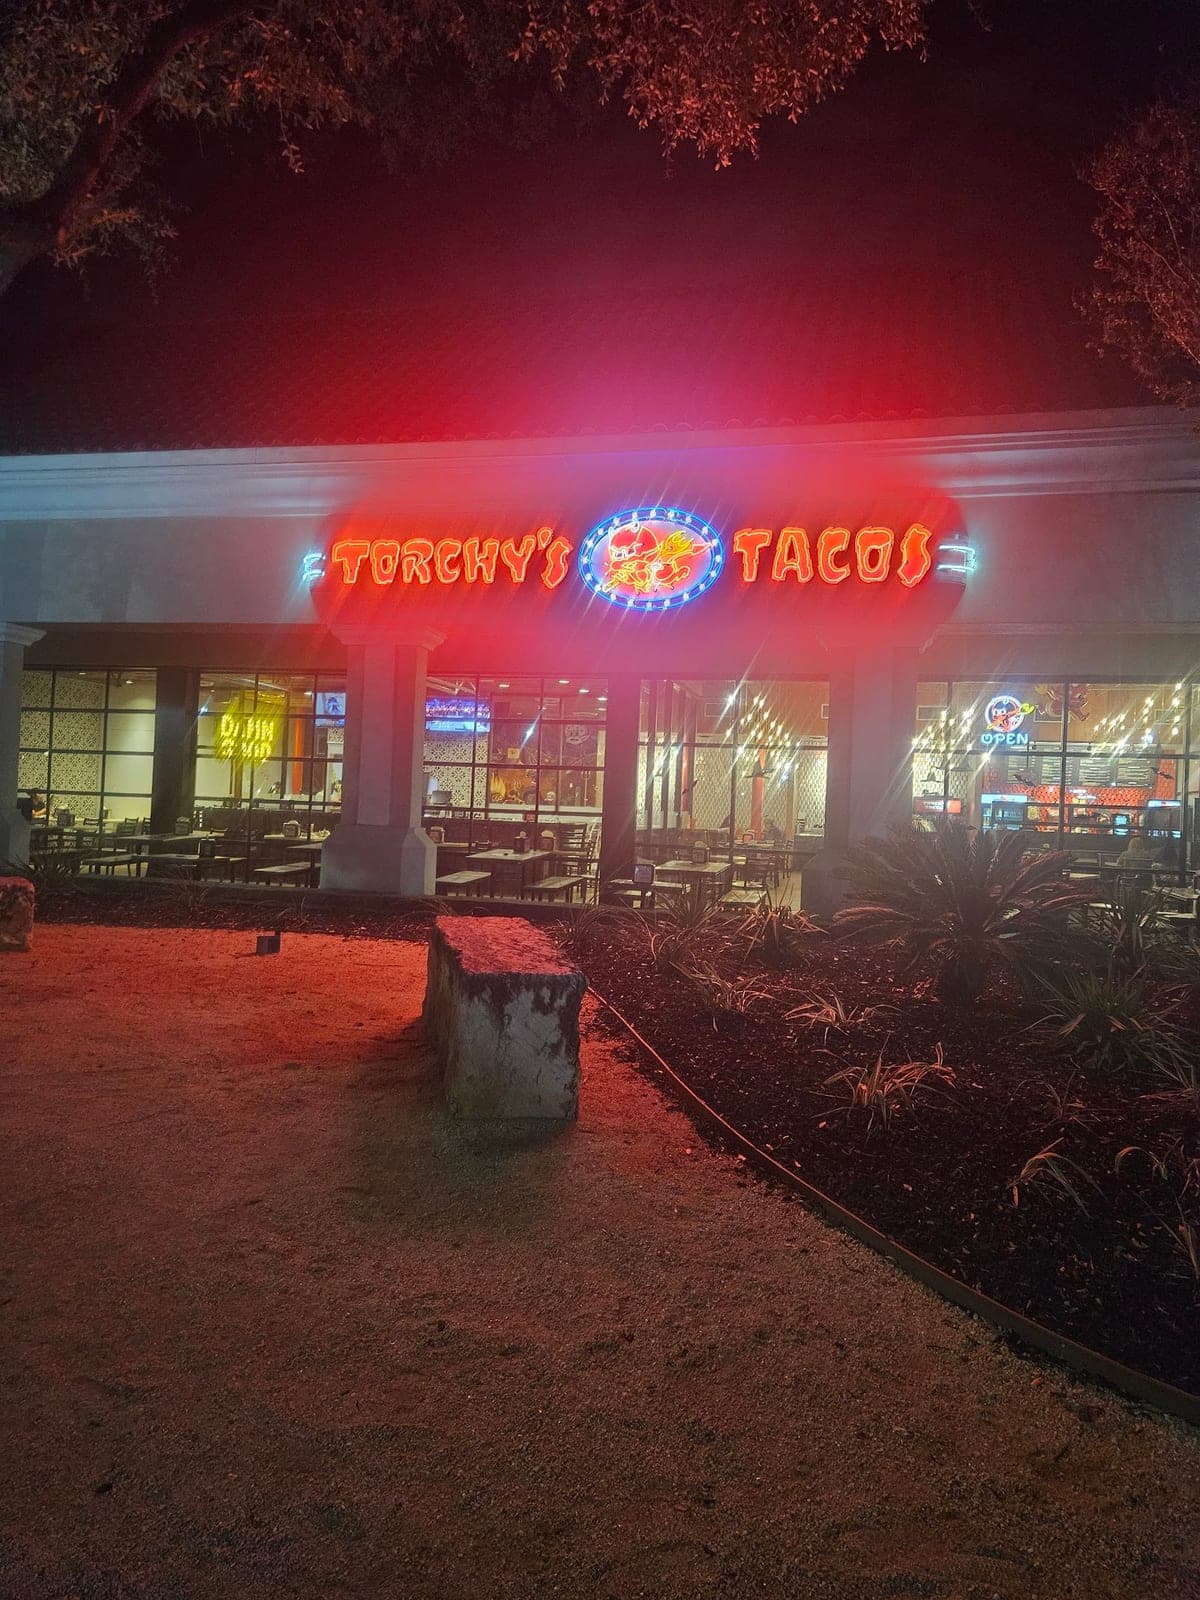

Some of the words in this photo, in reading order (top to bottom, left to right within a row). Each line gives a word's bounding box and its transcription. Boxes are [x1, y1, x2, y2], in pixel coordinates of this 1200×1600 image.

[331, 526, 572, 589] TORCHY'S
[733, 523, 932, 588] TACOS
[980, 732, 1029, 745] OPEN
